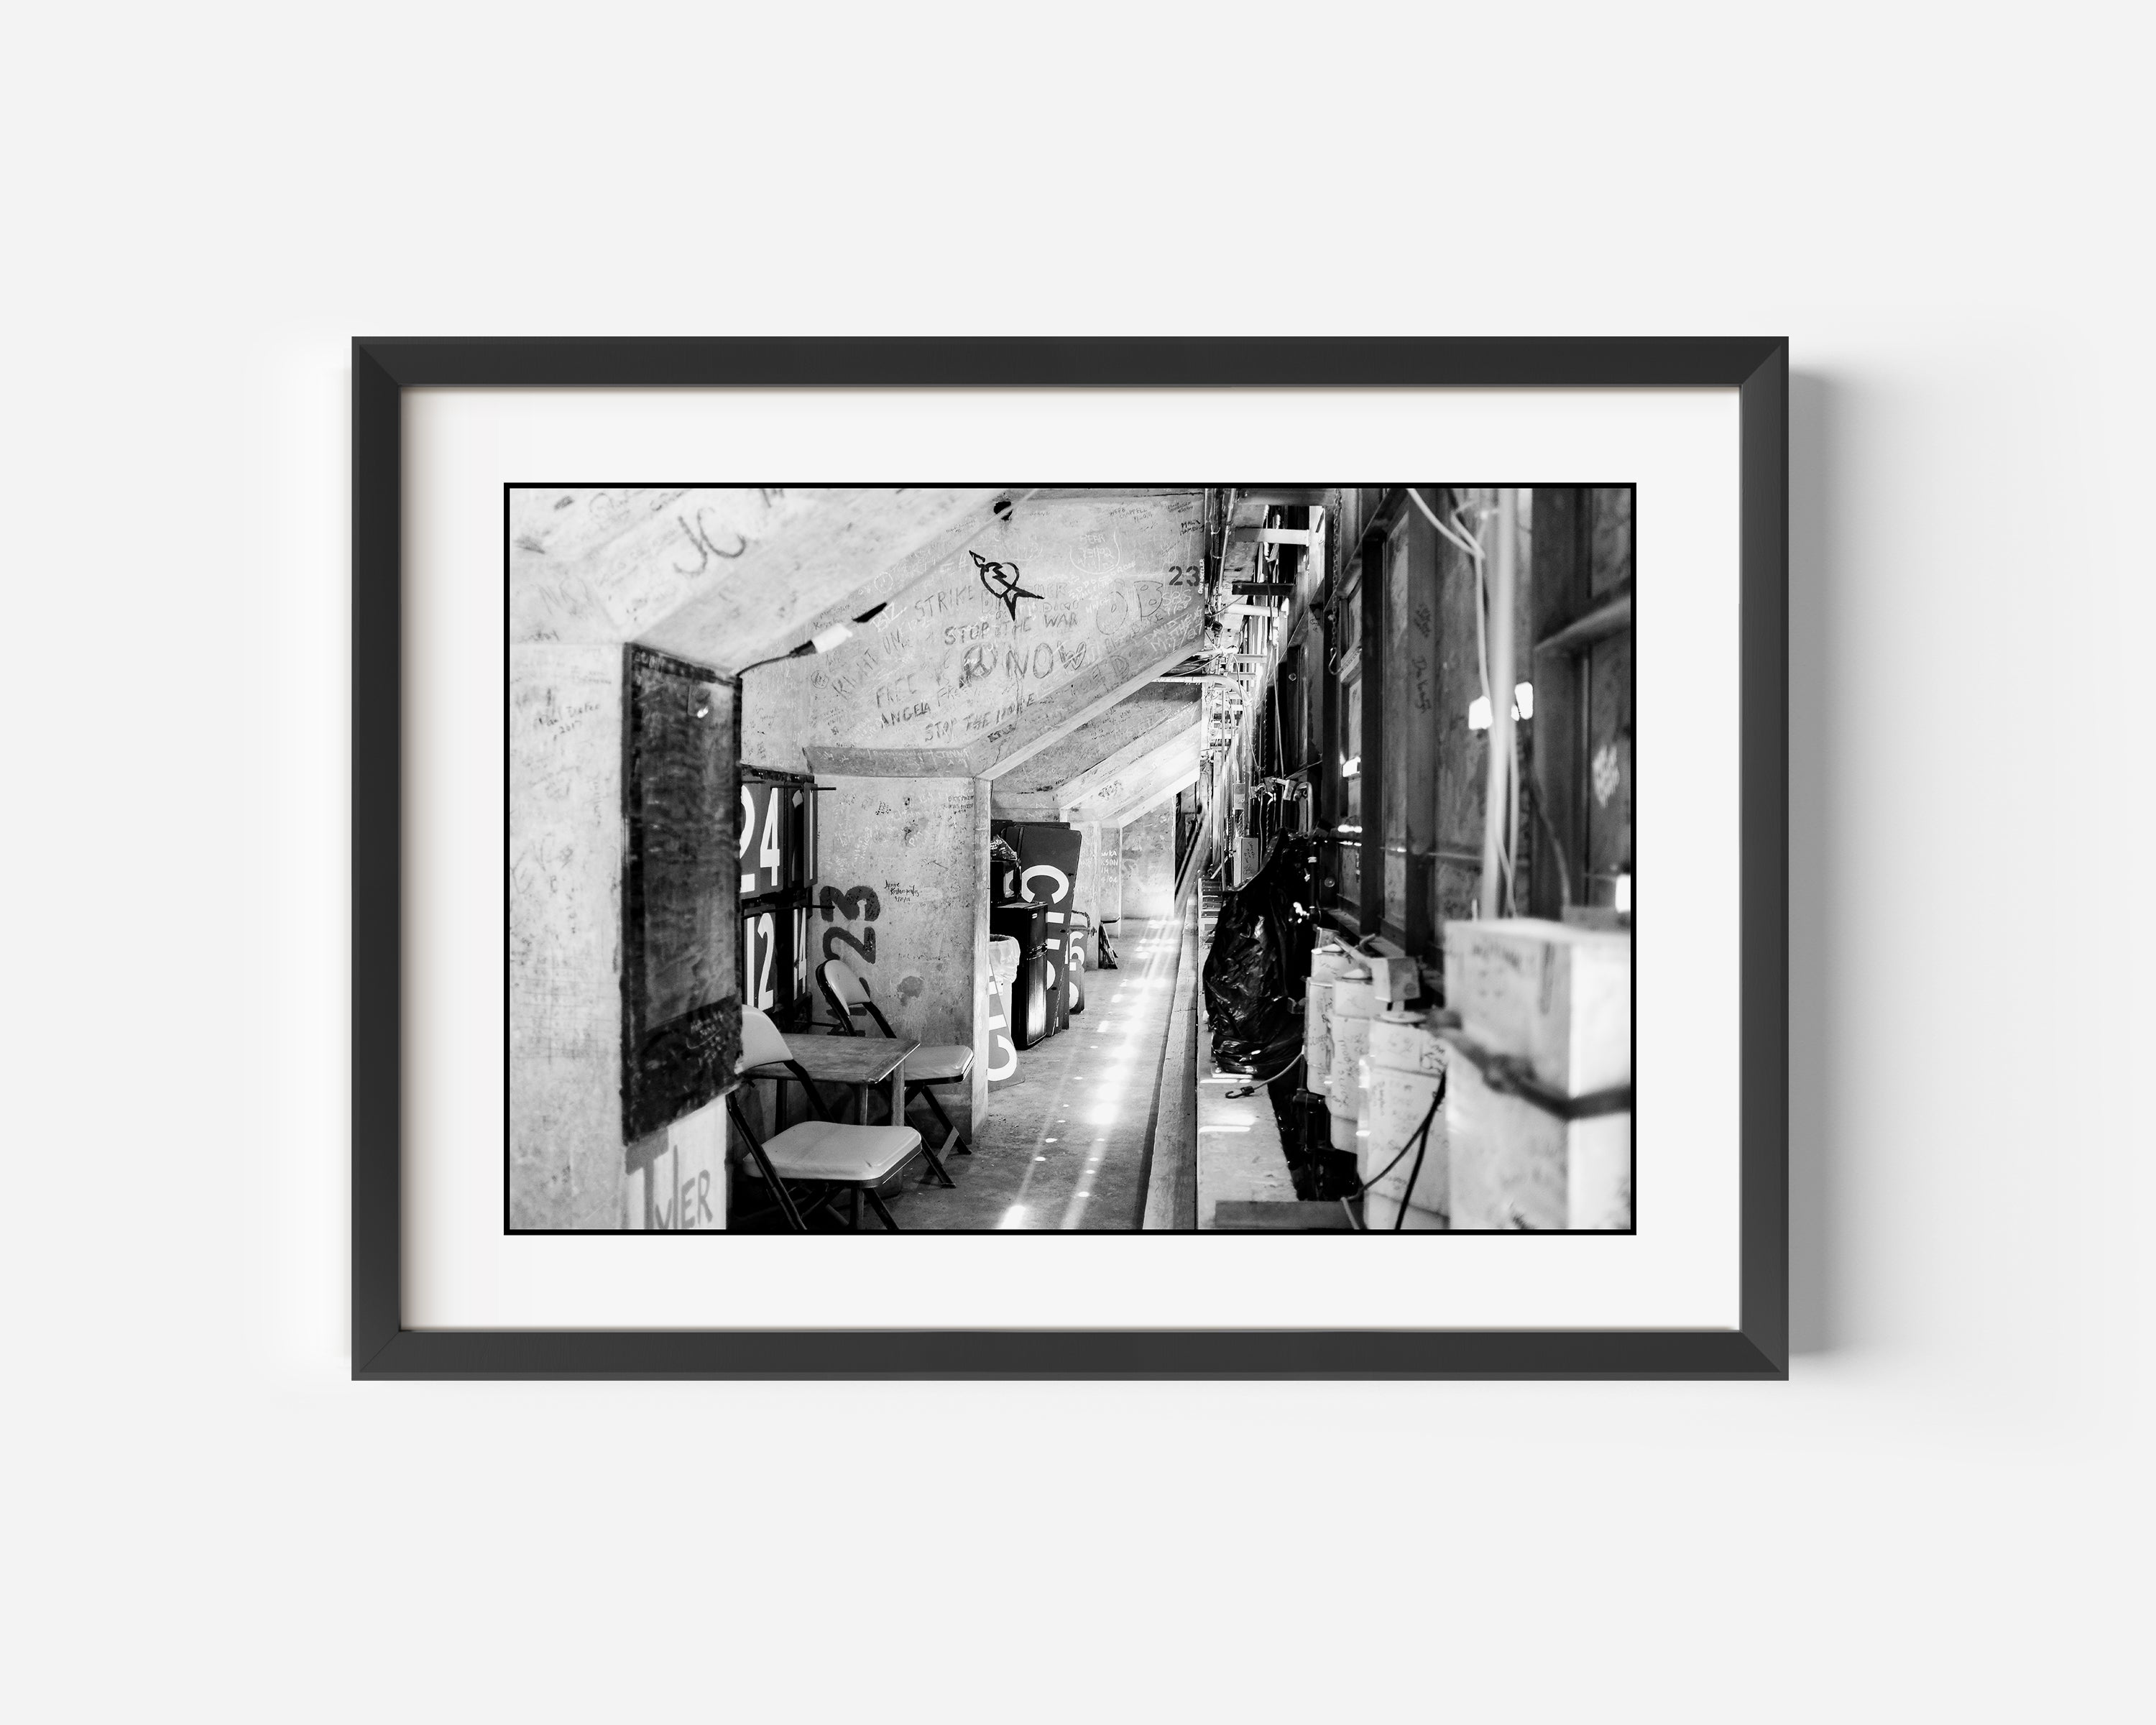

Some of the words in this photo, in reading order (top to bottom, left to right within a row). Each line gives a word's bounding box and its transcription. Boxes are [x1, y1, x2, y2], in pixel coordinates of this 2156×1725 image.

[673, 507, 747, 576] JC
[1169, 566, 1200, 586] 23
[915, 586, 974, 622] STRIKE
[944, 622, 991, 645] STOP
[1044, 612, 1079, 629] WAR
[1006, 641, 1087, 680] NOW
[747, 913, 774, 1012] 12
